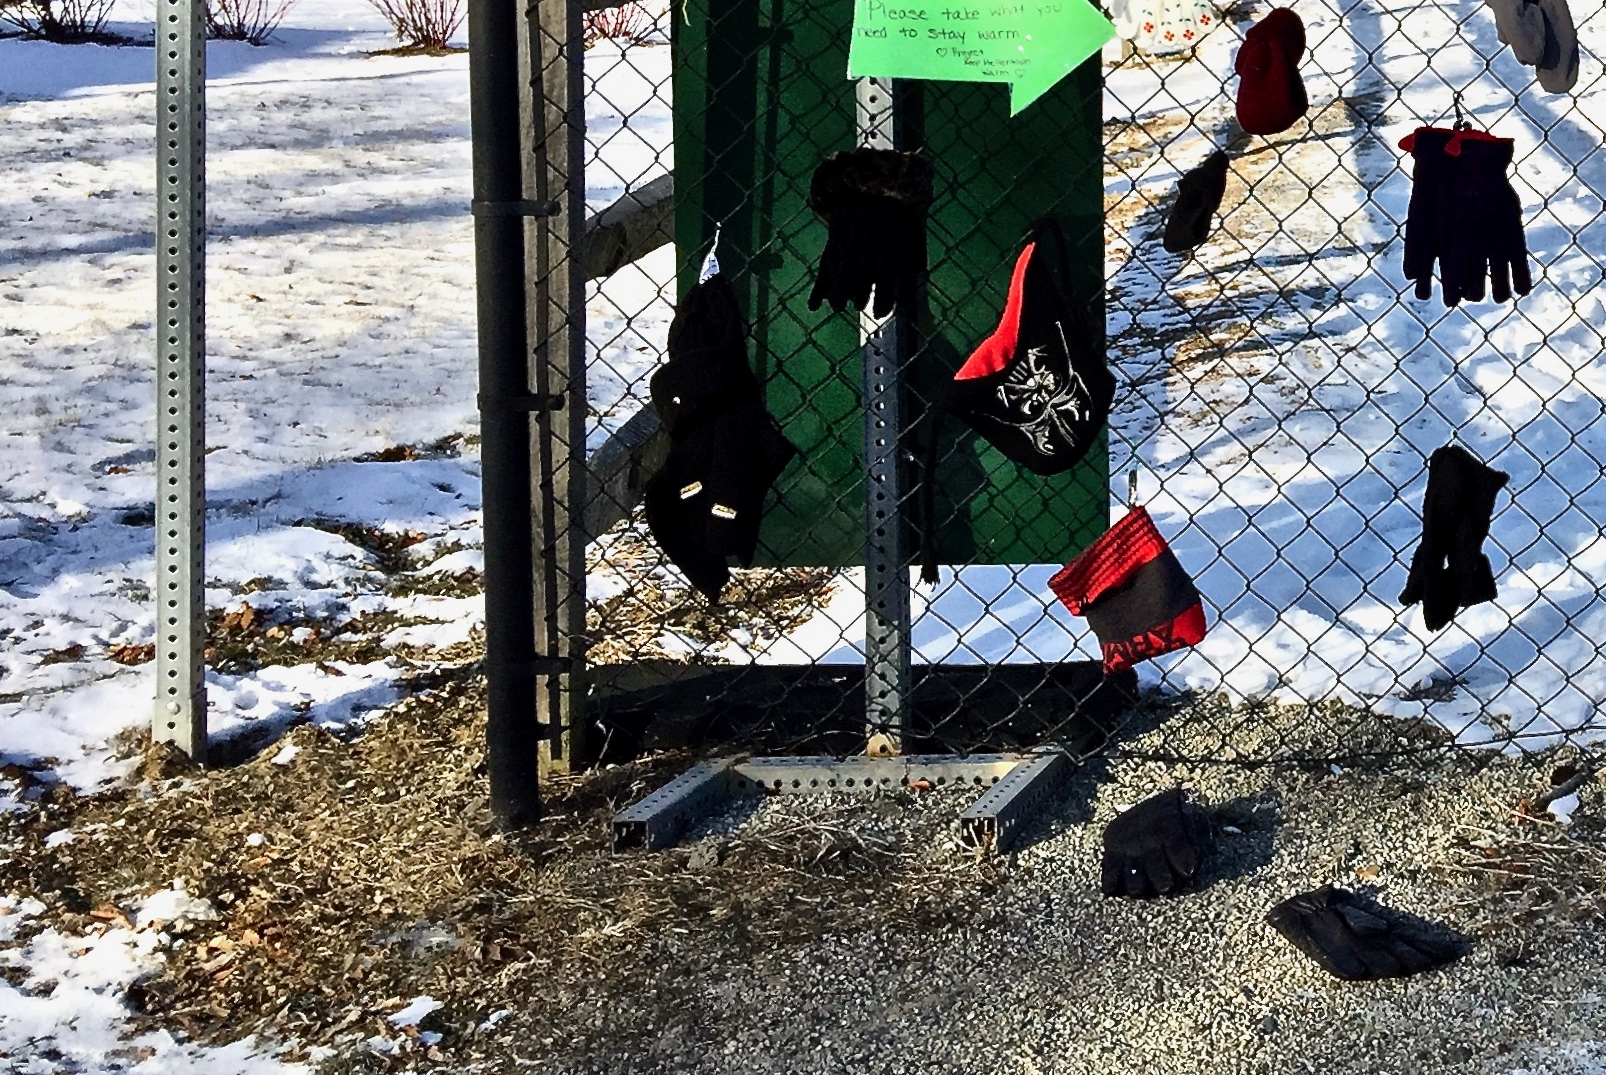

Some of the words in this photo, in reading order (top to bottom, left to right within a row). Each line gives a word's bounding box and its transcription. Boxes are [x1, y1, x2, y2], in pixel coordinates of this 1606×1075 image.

[941, 7, 980, 20] take
[1037, 3, 1062, 17] you
[857, 26, 887, 38] need
[899, 28, 918, 38] to
[928, 28, 966, 44] stay
[978, 28, 1020, 39] warm
